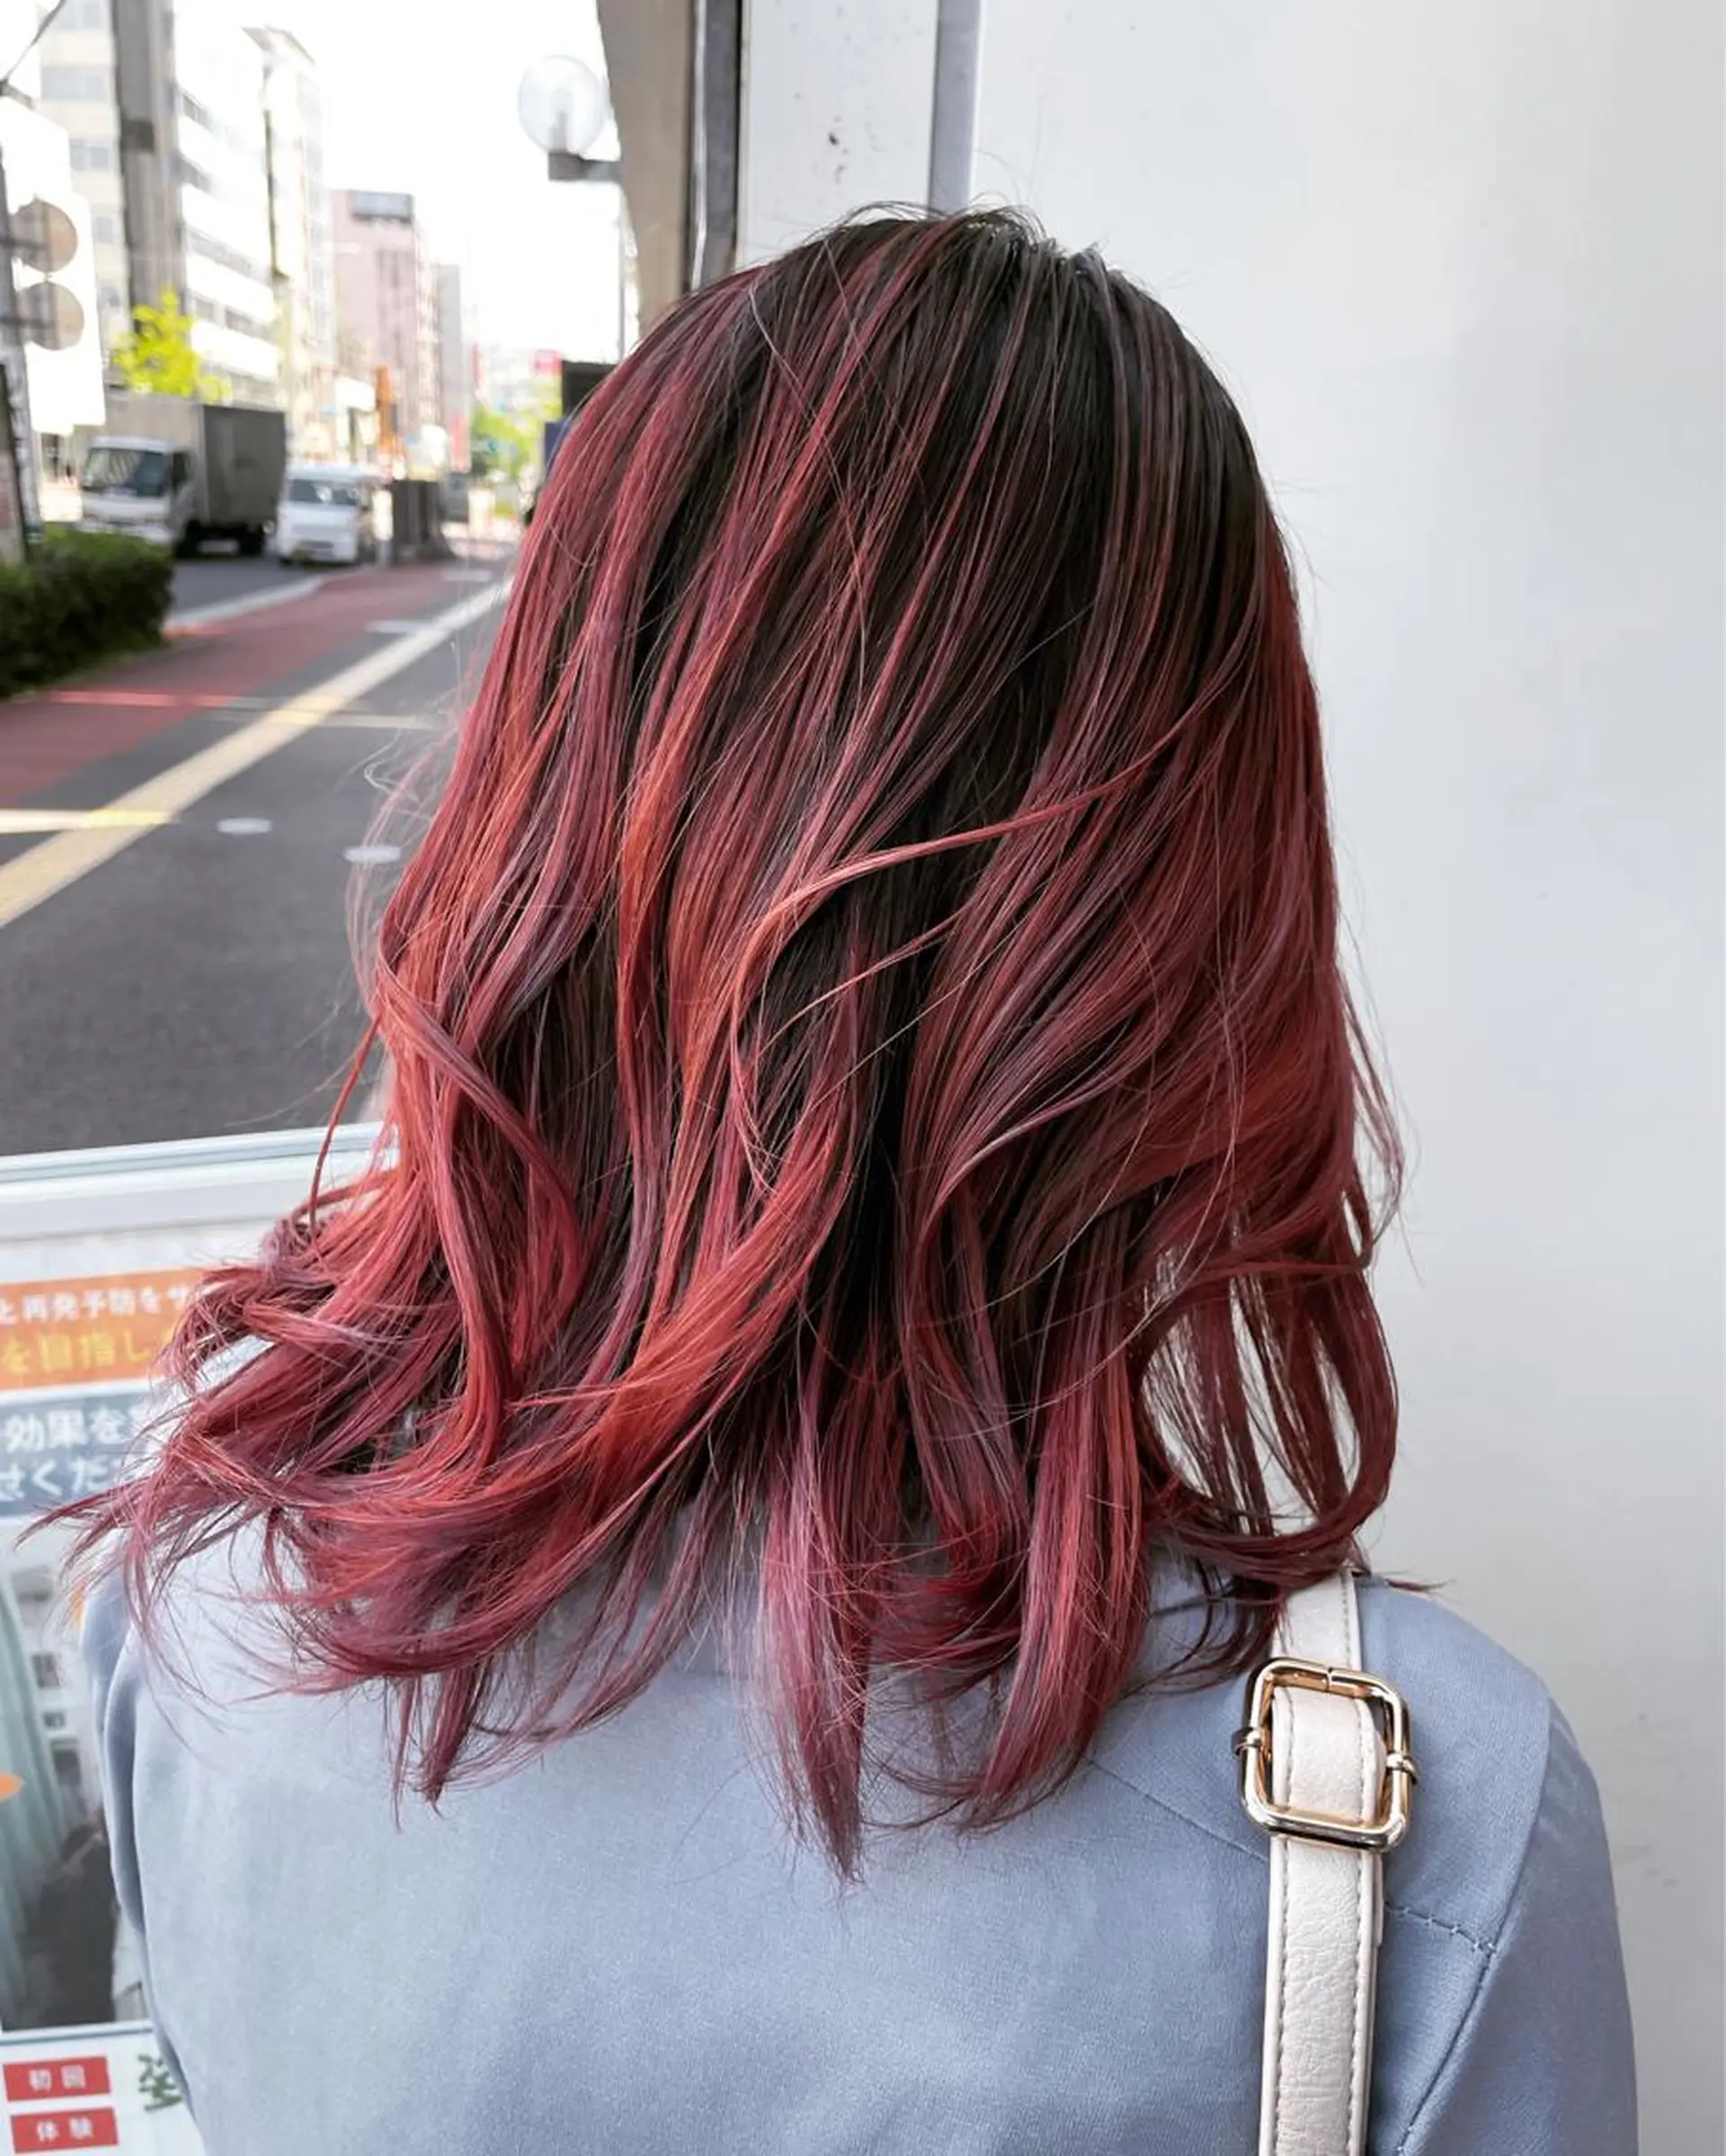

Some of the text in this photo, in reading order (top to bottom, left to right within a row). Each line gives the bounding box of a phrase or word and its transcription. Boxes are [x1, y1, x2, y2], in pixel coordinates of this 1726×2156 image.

[4, 1327, 172, 1377] を目指し
[4, 1404, 144, 1453] 効果を
[0, 1453, 123, 1502] せくだ
